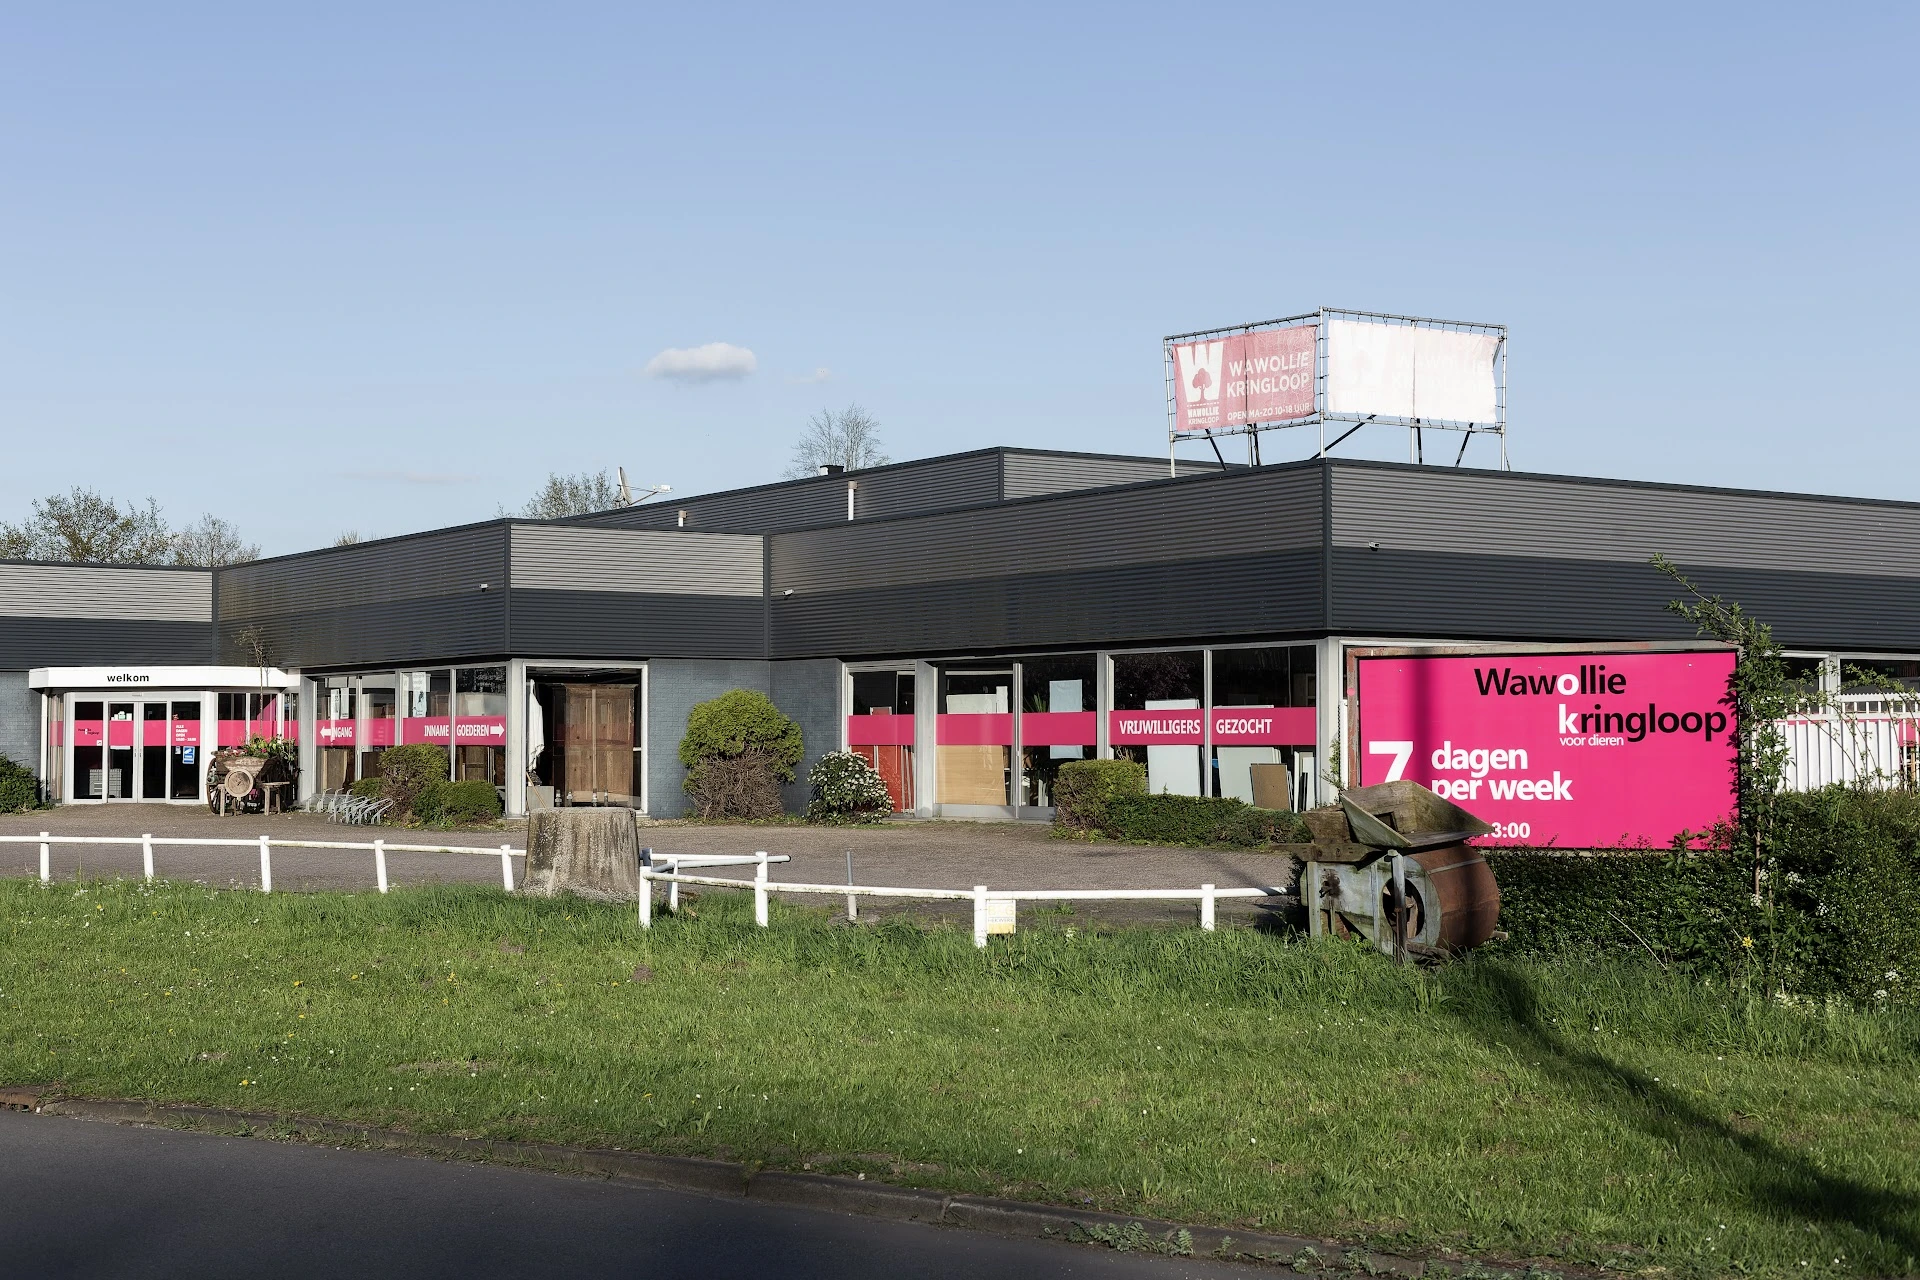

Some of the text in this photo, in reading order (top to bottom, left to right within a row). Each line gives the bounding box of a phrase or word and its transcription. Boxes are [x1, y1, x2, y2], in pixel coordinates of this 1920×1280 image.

[1229, 351, 1309, 376] WAWOLLIE
[1226, 373, 1309, 398] KRINGLOOP
[1187, 406, 1219, 418] WAWOLLIE
[1188, 416, 1219, 425] KRINGLOOP
[1227, 410, 1246, 421] OPEN
[1275, 404, 1293, 415] 10-18
[1294, 401, 1310, 412] UUR
[107, 674, 150, 682] welkom
[1474, 664, 1627, 696] Wawollie
[424, 724, 489, 737] INNAME GOEDEREN
[1119, 718, 1272, 735] VRIJWILLIGERS GEZOCHT
[1558, 703, 1727, 743] kringloop
[1560, 734, 1624, 746] voor dieren
[1369, 741, 1413, 783] 7
[1431, 741, 1528, 778] dagen
[1431, 771, 1574, 801] per week
